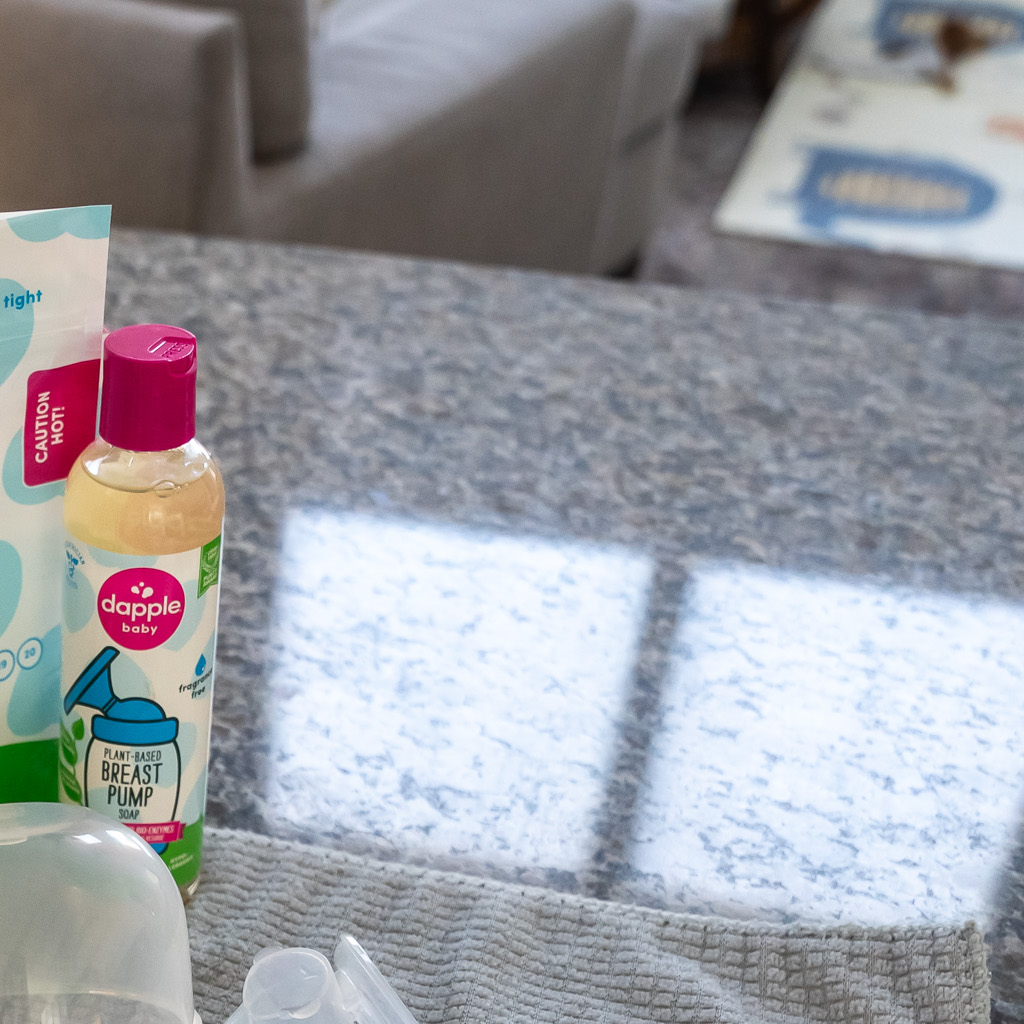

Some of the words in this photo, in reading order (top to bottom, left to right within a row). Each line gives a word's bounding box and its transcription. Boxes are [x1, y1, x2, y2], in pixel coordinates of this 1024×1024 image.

[3, 290, 43, 310] tight
[35, 391, 51, 464] CAUTION
[51, 406, 65, 445] HOT!
[101, 593, 182, 622] dapple
[122, 622, 158, 636] baby
[24, 647, 36, 658] 20
[190, 686, 206, 699] free
[103, 747, 162, 763] PLANT-BASED
[101, 761, 163, 785] BREAST
[107, 785, 154, 807] PUMP
[118, 809, 140, 820] SOAP
